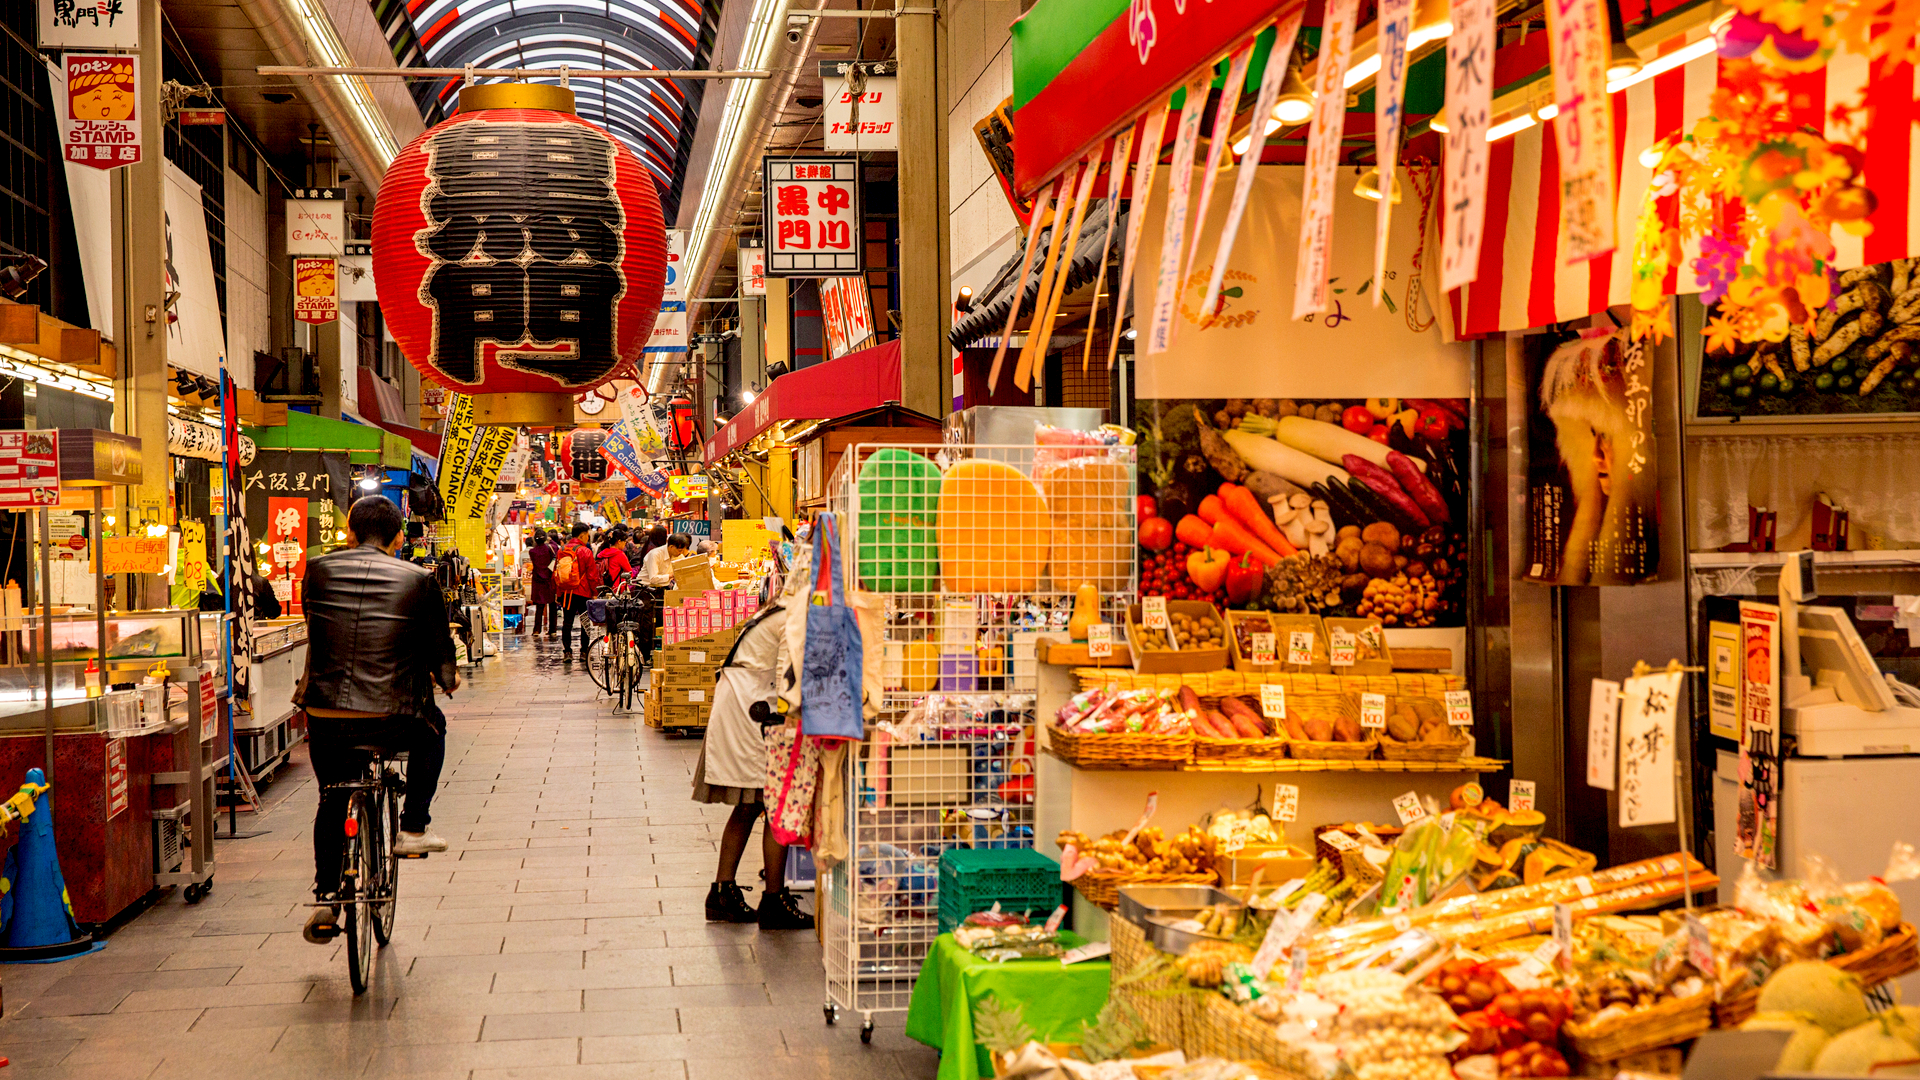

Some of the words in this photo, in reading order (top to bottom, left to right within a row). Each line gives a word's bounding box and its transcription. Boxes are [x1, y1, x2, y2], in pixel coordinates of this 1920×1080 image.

[69, 60, 112, 76] クロモン
[74, 120, 128, 131] フレッシュ
[69, 131, 136, 144] STAMP
[70, 146, 136, 160] 加盟店
[795, 165, 832, 180] 生鮮館
[777, 185, 811, 251] 黒門
[818, 185, 851, 250] 中川
[298, 261, 322, 271] クロモン
[300, 295, 331, 303] フレッシュ
[297, 302, 335, 310] STAMP
[298, 311, 335, 320] 加盟店
[653, 328, 679, 336] 通行禁止
[487, 429, 515, 476] MONEY
[245, 470, 330, 493] 大阪黒門
[446, 437, 470, 514] EXCHANGE
[1145, 615, 1163, 626] 180
[1091, 642, 1110, 654] 580
[1333, 652, 1354, 662] 250
[1265, 703, 1282, 713] 100
[1362, 711, 1382, 724] 100
[1451, 711, 1470, 721] 100
